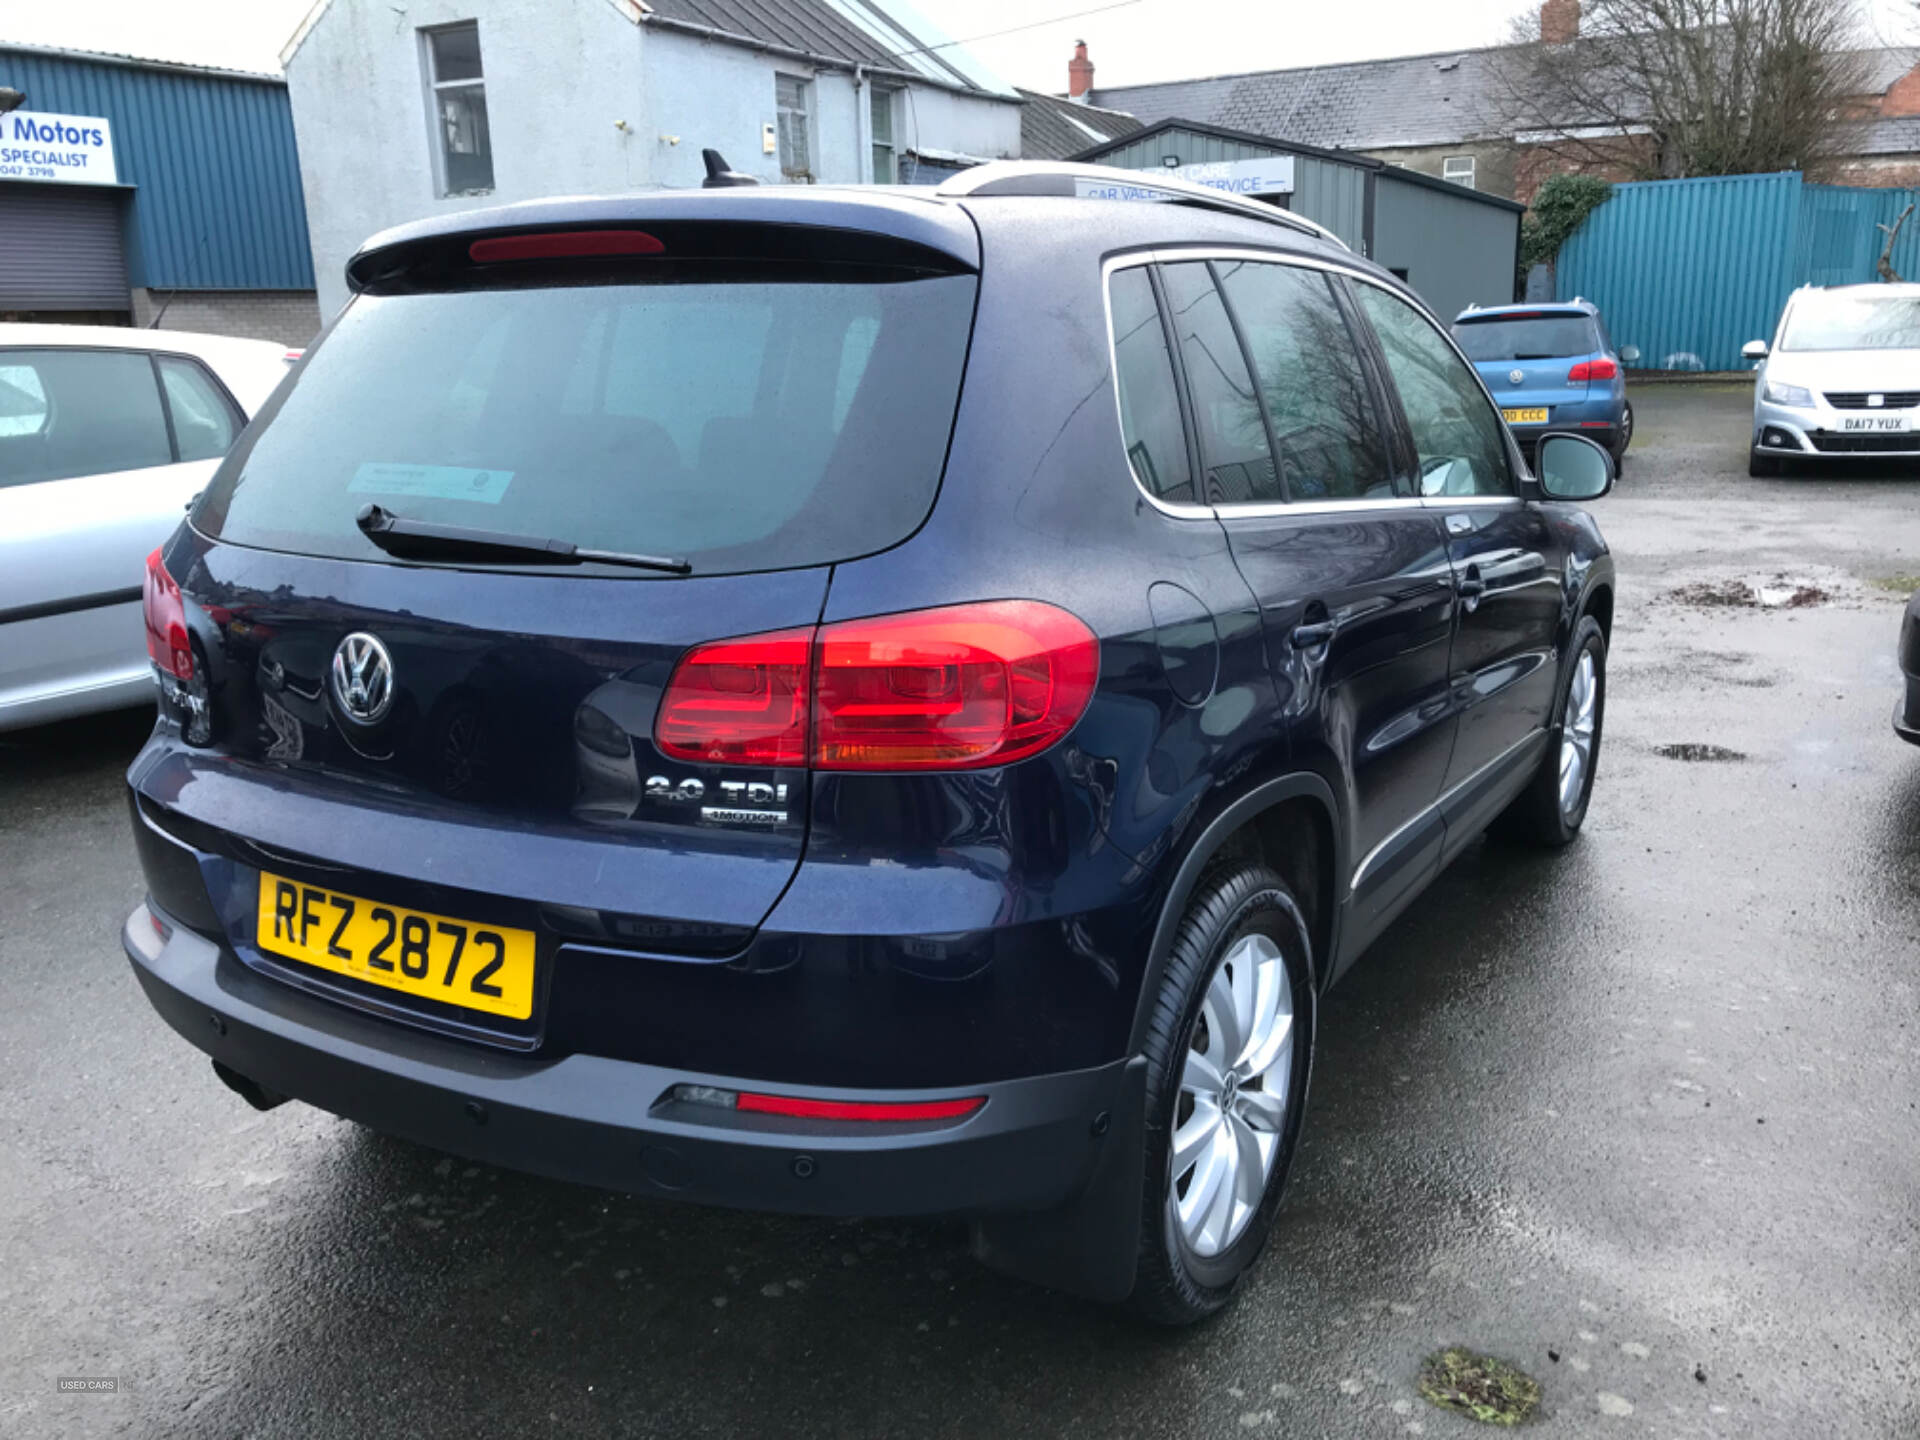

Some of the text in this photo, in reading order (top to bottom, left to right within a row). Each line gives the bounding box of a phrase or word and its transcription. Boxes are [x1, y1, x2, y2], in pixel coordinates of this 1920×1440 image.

[14, 117, 104, 147] Motors
[1, 148, 88, 168] SPECIALIST
[0, 165, 23, 175] 047
[1845, 418, 1903, 429] DA17 YUX
[645, 775, 788, 803] 2.0 TDI
[710, 810, 780, 824] 4MOTION
[273, 879, 506, 999] RFZ 2872
